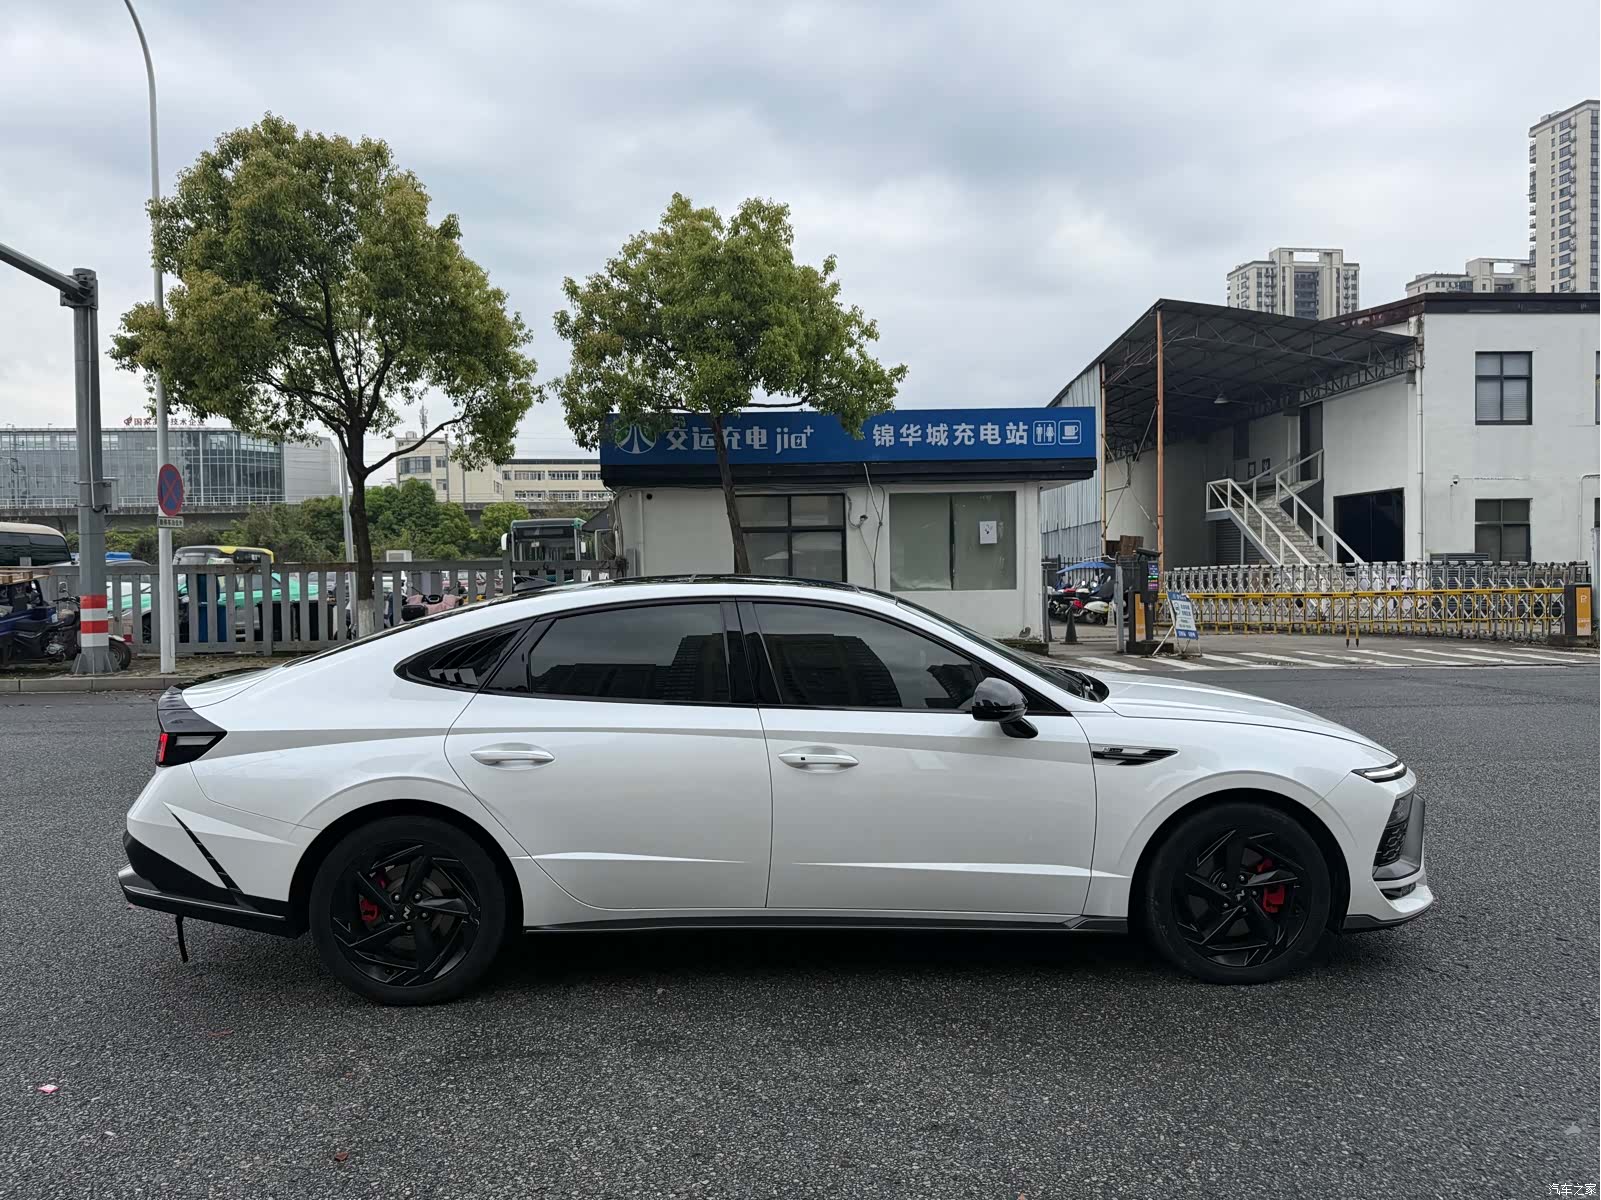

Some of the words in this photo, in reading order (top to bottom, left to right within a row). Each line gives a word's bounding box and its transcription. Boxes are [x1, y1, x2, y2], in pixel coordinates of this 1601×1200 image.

[664, 425, 768, 451] 交运充电
[872, 421, 1028, 447] 锦华城充电站
